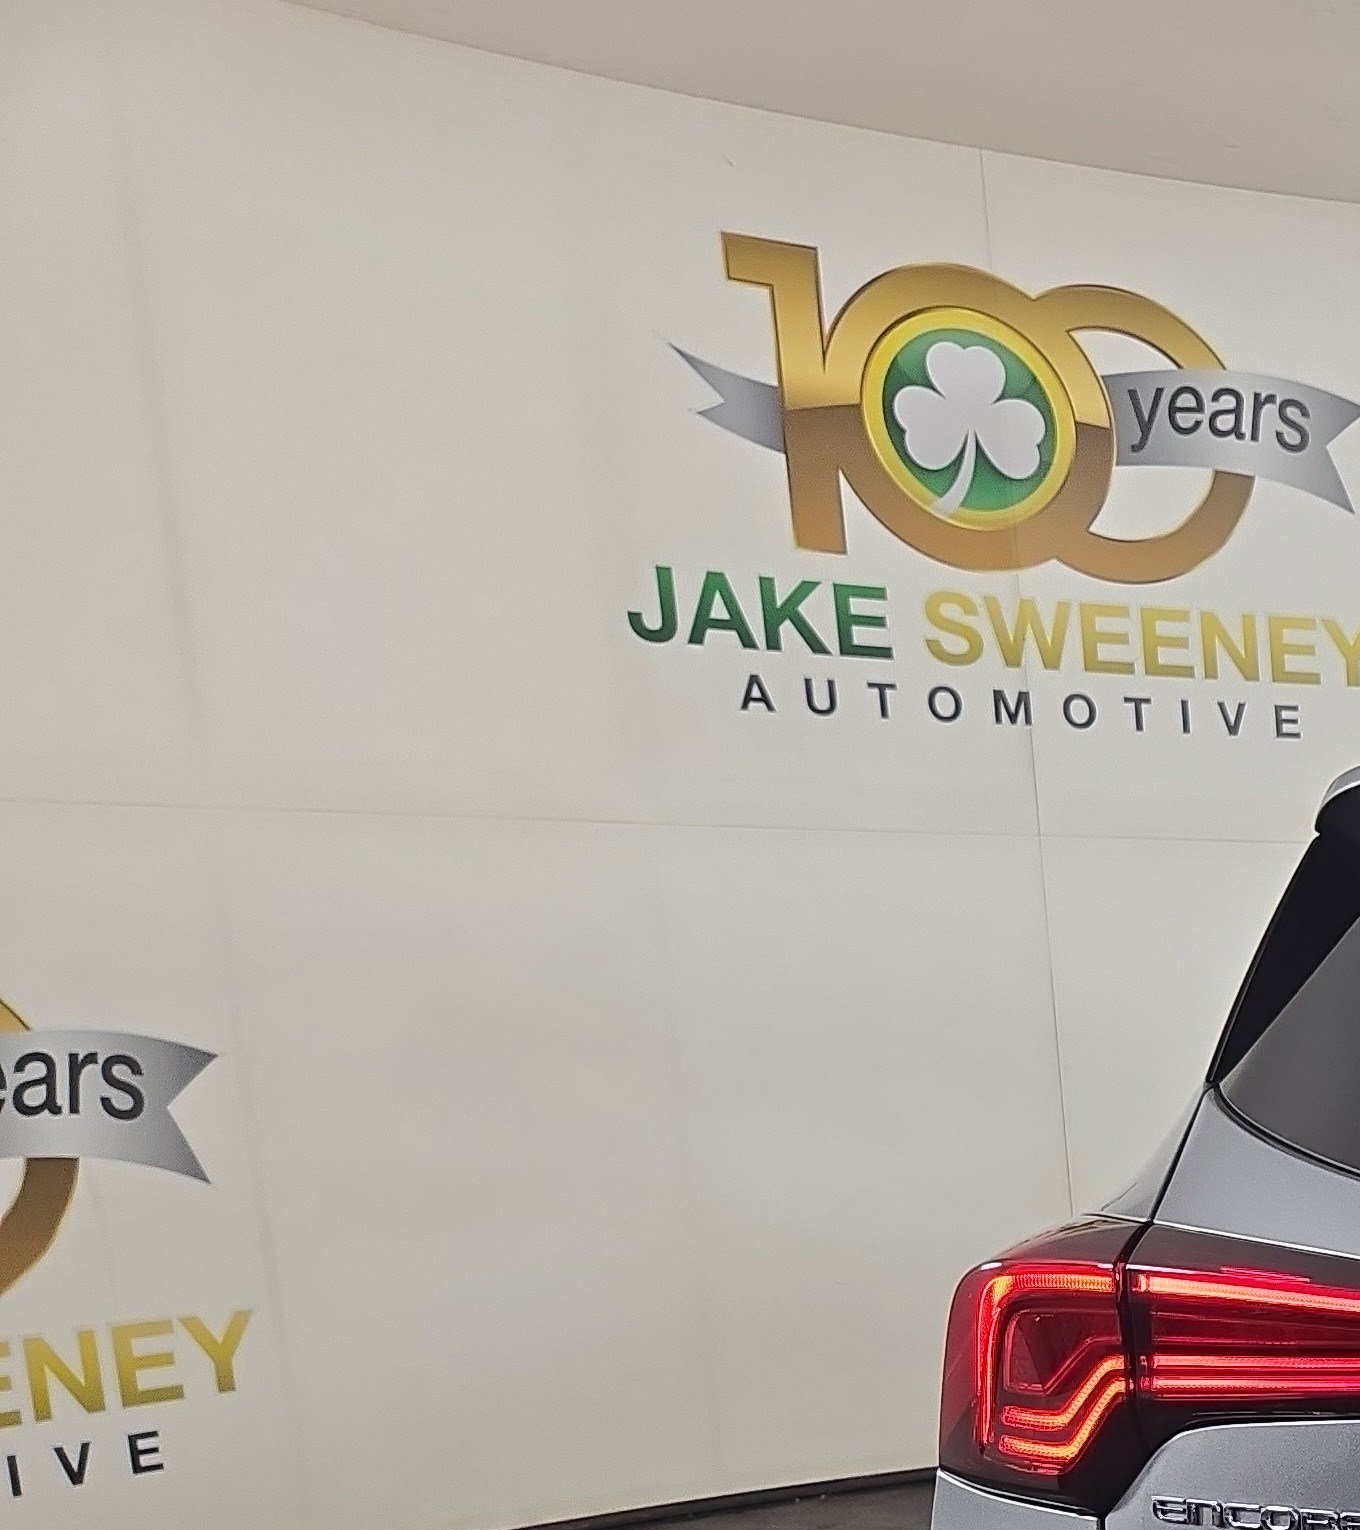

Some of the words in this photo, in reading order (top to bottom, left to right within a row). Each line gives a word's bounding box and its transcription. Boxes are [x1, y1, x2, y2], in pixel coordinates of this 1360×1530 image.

[722, 231, 1256, 584] 100
[1127, 384, 1311, 454] years
[627, 564, 893, 660] JAKE
[740, 674, 1302, 740] AUTOMOTIVE
[0, 1051, 145, 1121] ars
